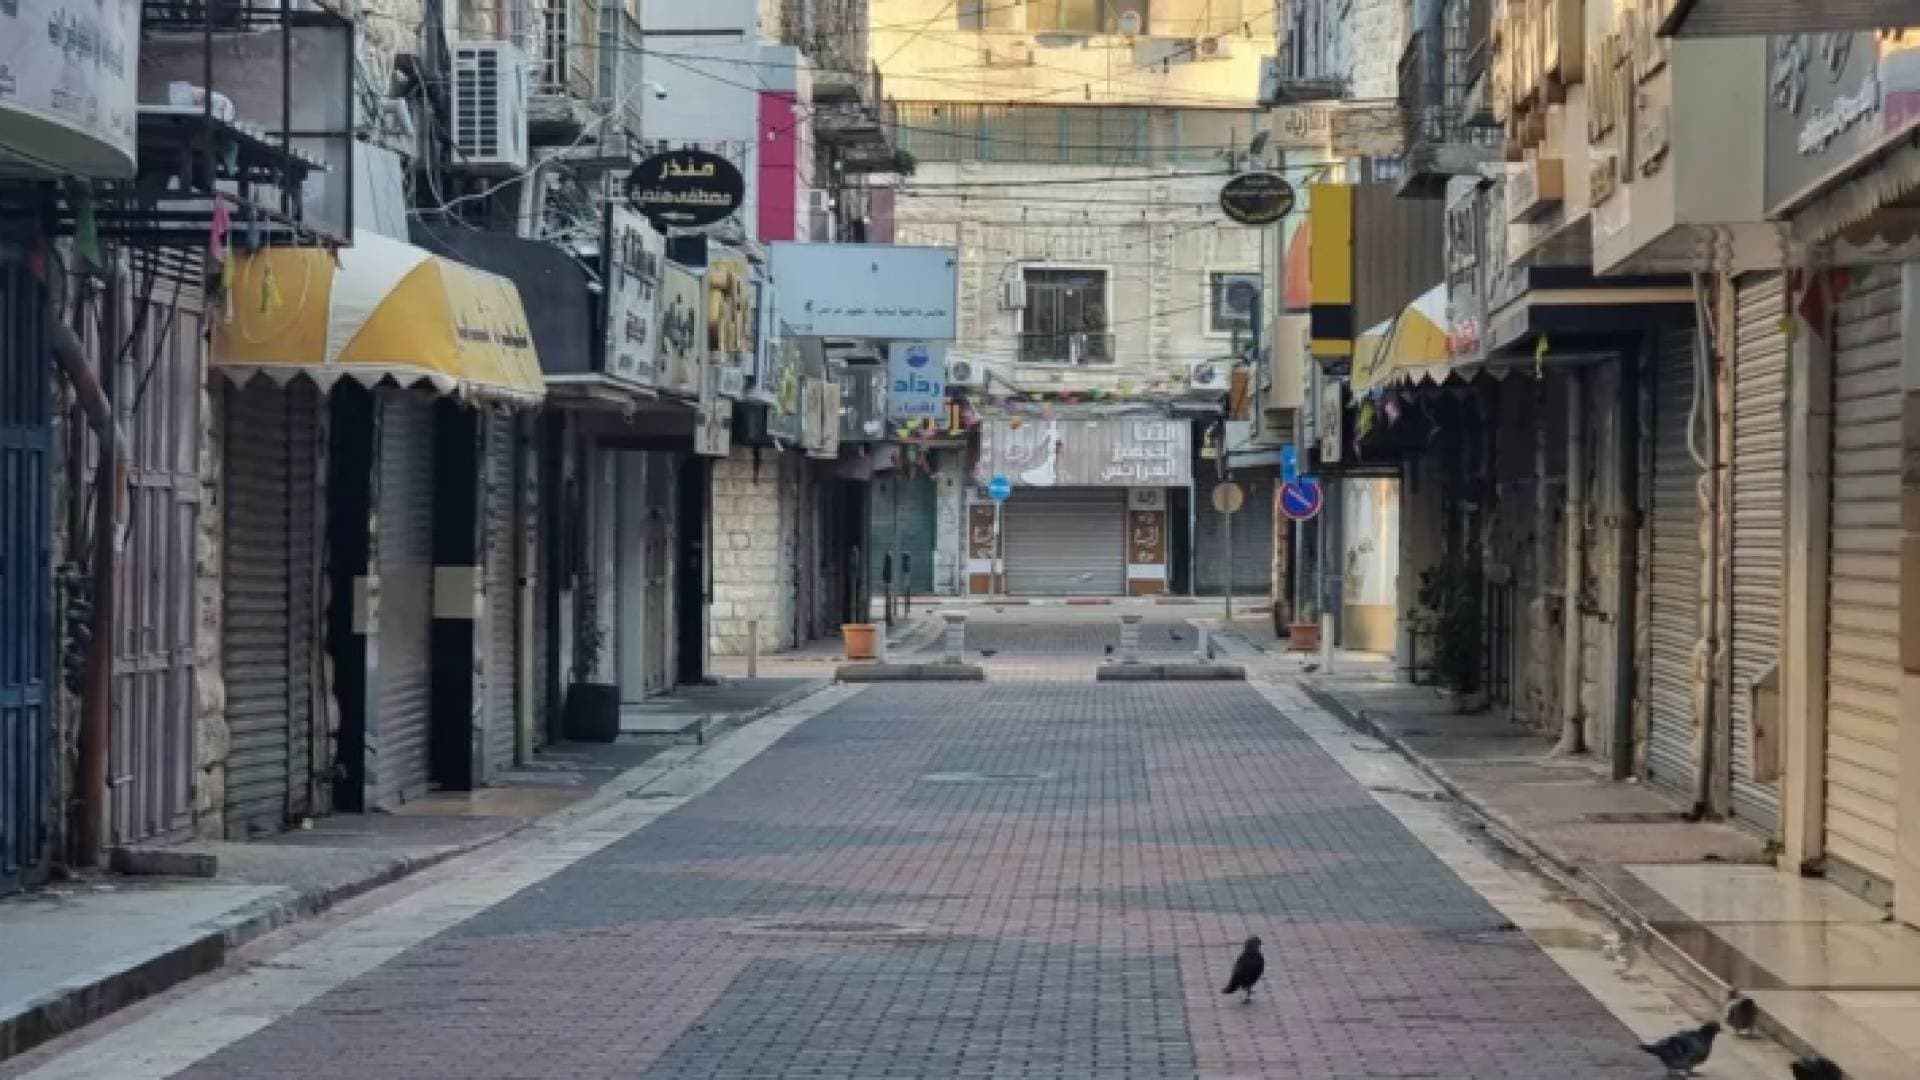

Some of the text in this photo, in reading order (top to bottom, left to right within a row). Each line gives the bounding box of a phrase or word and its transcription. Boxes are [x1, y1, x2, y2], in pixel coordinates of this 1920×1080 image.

[659, 157, 715, 181] منذر
[674, 187, 733, 206] مصطفى
[1100, 458, 1176, 482] العرائس
